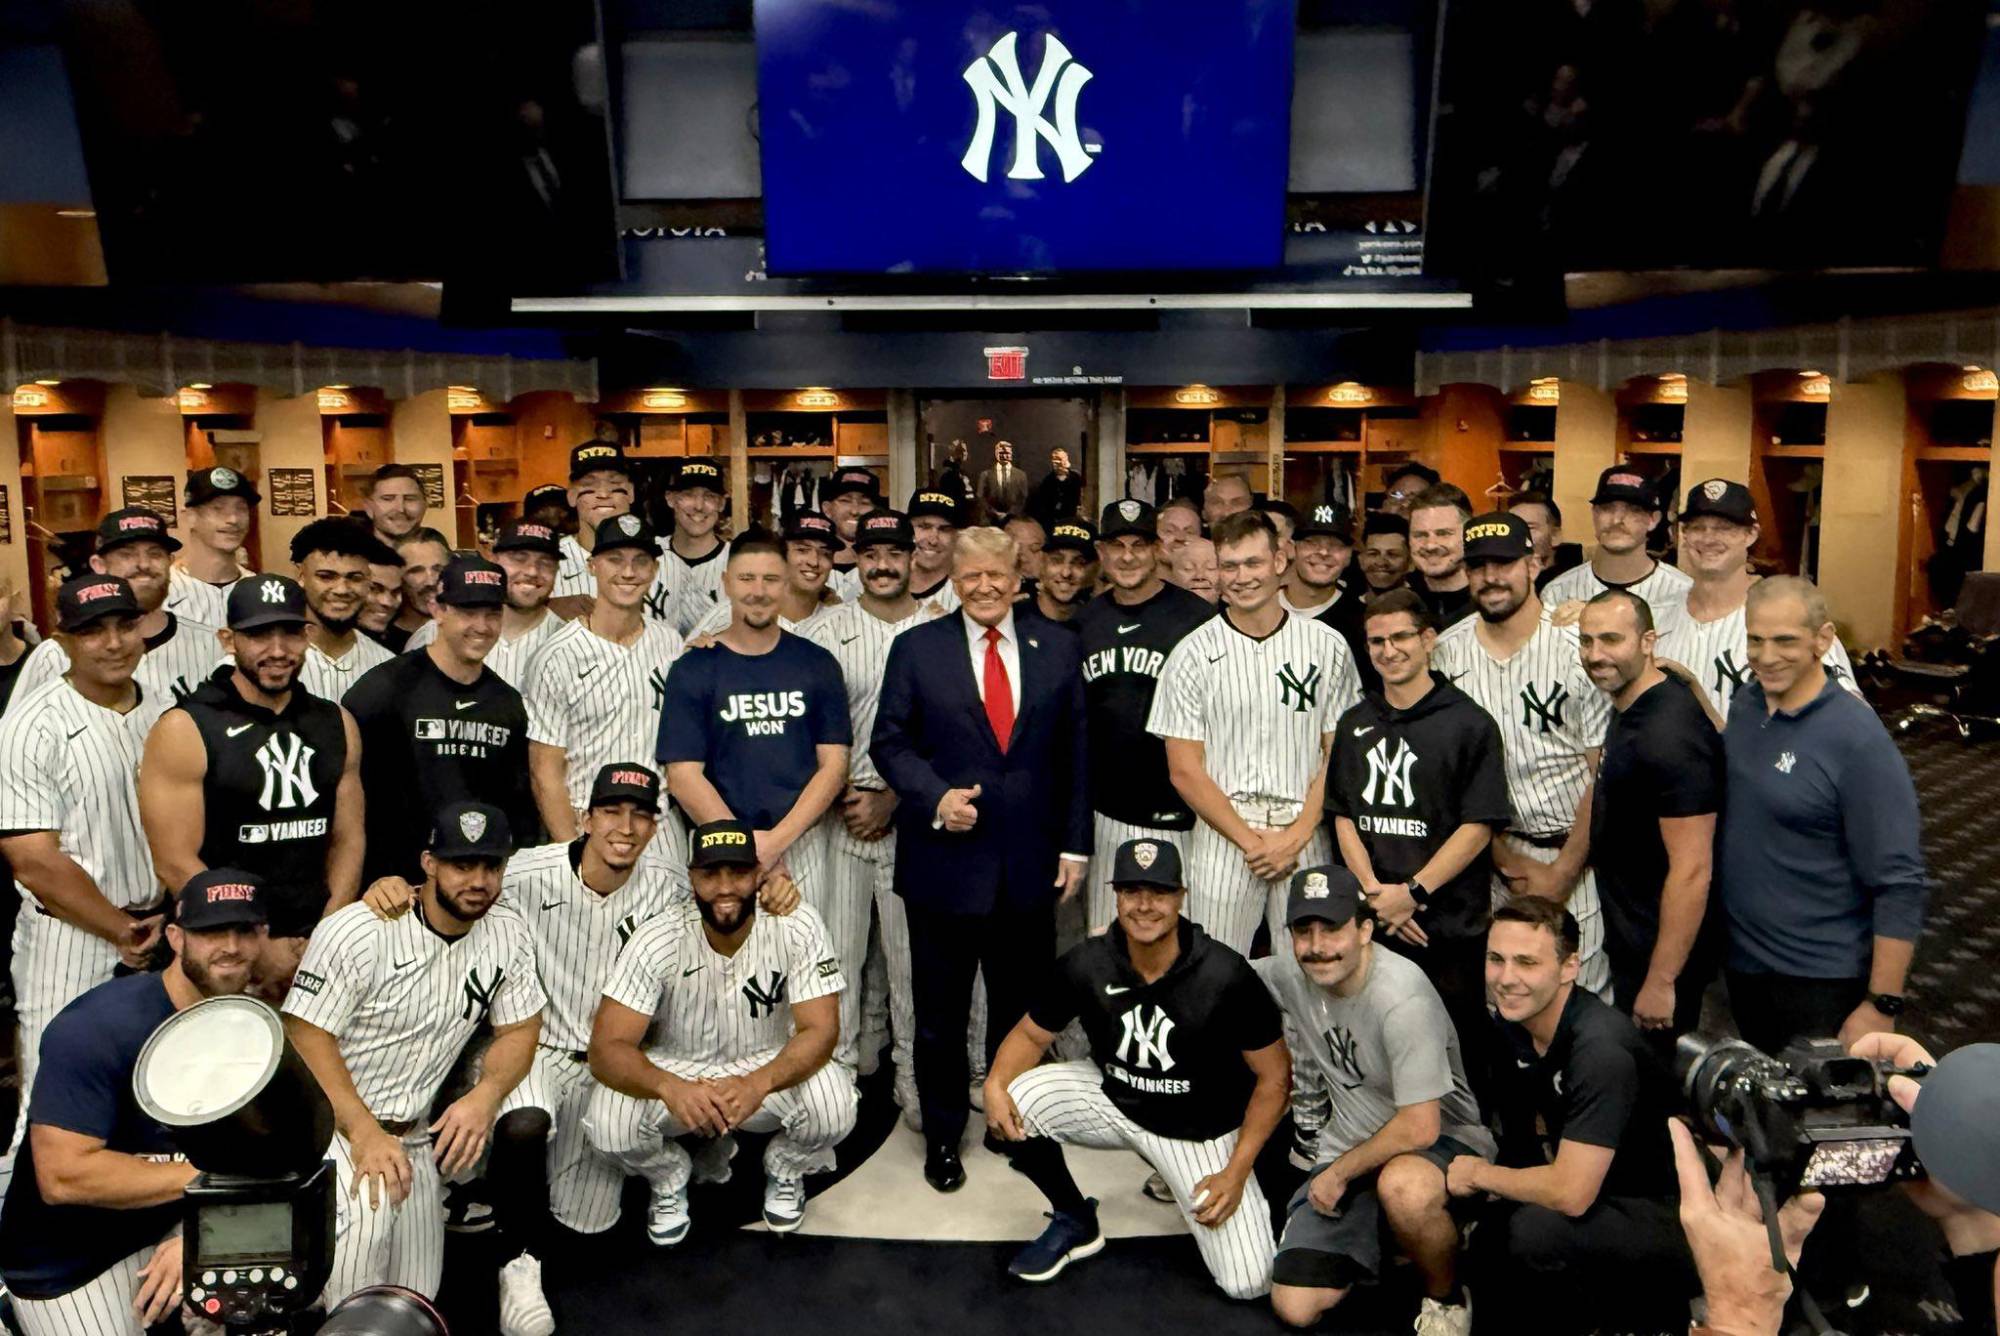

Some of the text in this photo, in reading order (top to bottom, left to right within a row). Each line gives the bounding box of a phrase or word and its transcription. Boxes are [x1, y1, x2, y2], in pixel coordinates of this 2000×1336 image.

[962, 31, 1095, 183] NY
[577, 446, 617, 461] NYPD
[1053, 525, 1091, 540] NYPD
[1464, 523, 1511, 542] NYPD
[261, 580, 286, 603] NY
[1082, 646, 1164, 683] NEW YOR
[1276, 661, 1322, 712] NY
[720, 691, 806, 722] JESUS
[1519, 680, 1569, 732] NY
[745, 720, 786, 736] WON
[255, 732, 320, 811] NY
[1361, 737, 1418, 807] NY
[270, 818, 327, 841] YANKEES
[1373, 817, 1427, 837] YANKEES
[701, 831, 747, 848] NYPD
[1115, 1003, 1176, 1072] NY
[1129, 1075, 1191, 1094] YANKEES
